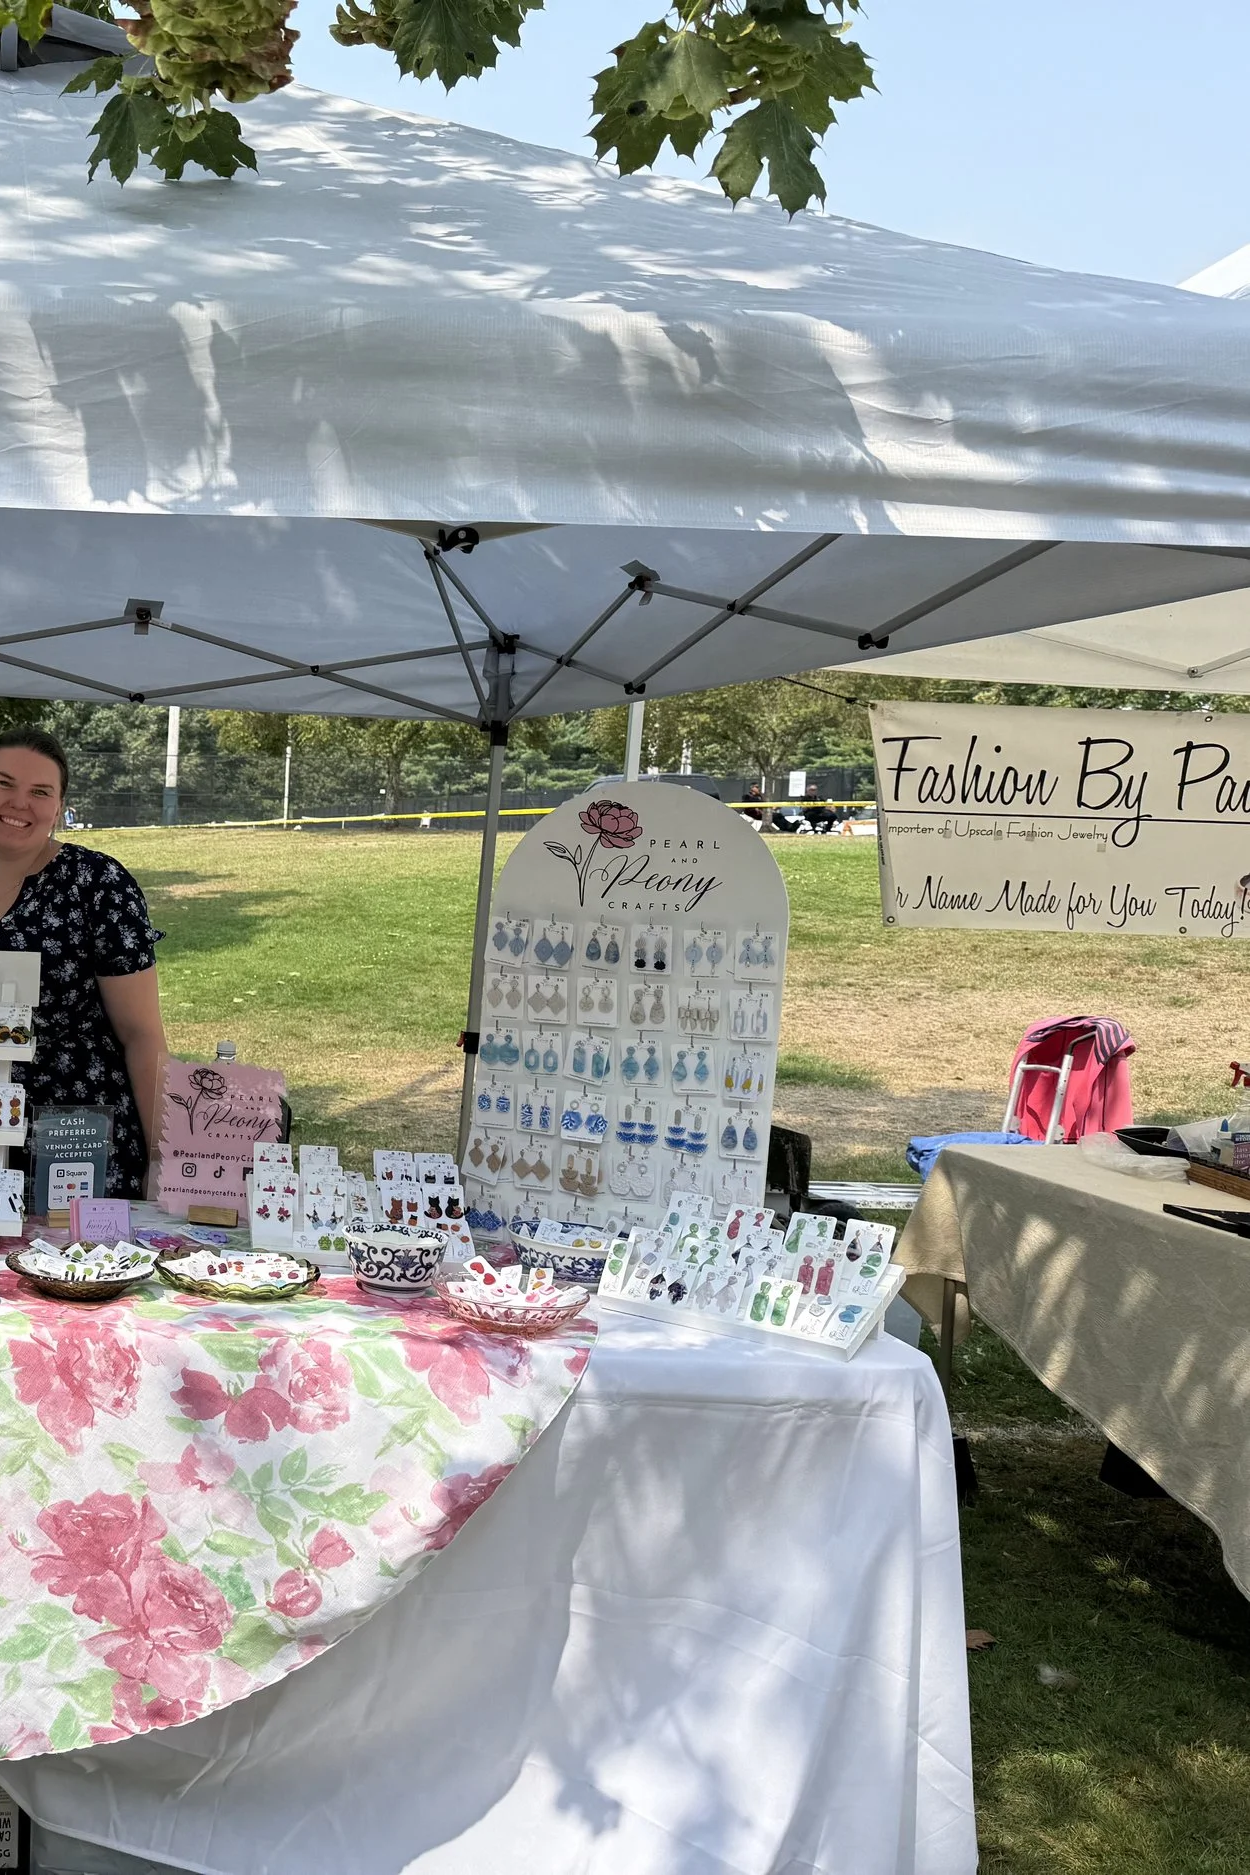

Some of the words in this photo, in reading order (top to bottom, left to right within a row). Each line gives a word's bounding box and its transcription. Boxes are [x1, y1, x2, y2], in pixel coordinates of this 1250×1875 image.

[882, 734, 1059, 806] Fashion
[1077, 736, 1152, 848] By
[937, 819, 951, 836] of
[954, 819, 1003, 838] Upscale
[1006, 821, 1054, 840] Fashion
[1057, 823, 1109, 844] Jewelry
[649, 838, 721, 850] PEARL
[589, 854, 723, 913] Peony
[608, 900, 681, 912] CRAFTS
[911, 875, 983, 912] Name
[984, 879, 1060, 917] Made
[1065, 881, 1104, 931] for
[1106, 883, 1158, 929] You
[1164, 885, 1247, 939] Today!
[230, 1094, 274, 1103] PEARL
[60, 1118, 85, 1126] CASH
[195, 1103, 278, 1141] Peony
[48, 1128, 97, 1137] PREFERRED
[207, 1132, 252, 1141] CRAFTS
[44, 1143, 73, 1151] VENMO
[54, 1151, 93, 1159] ACCEPTED
[66, 1169, 88, 1177] Square
